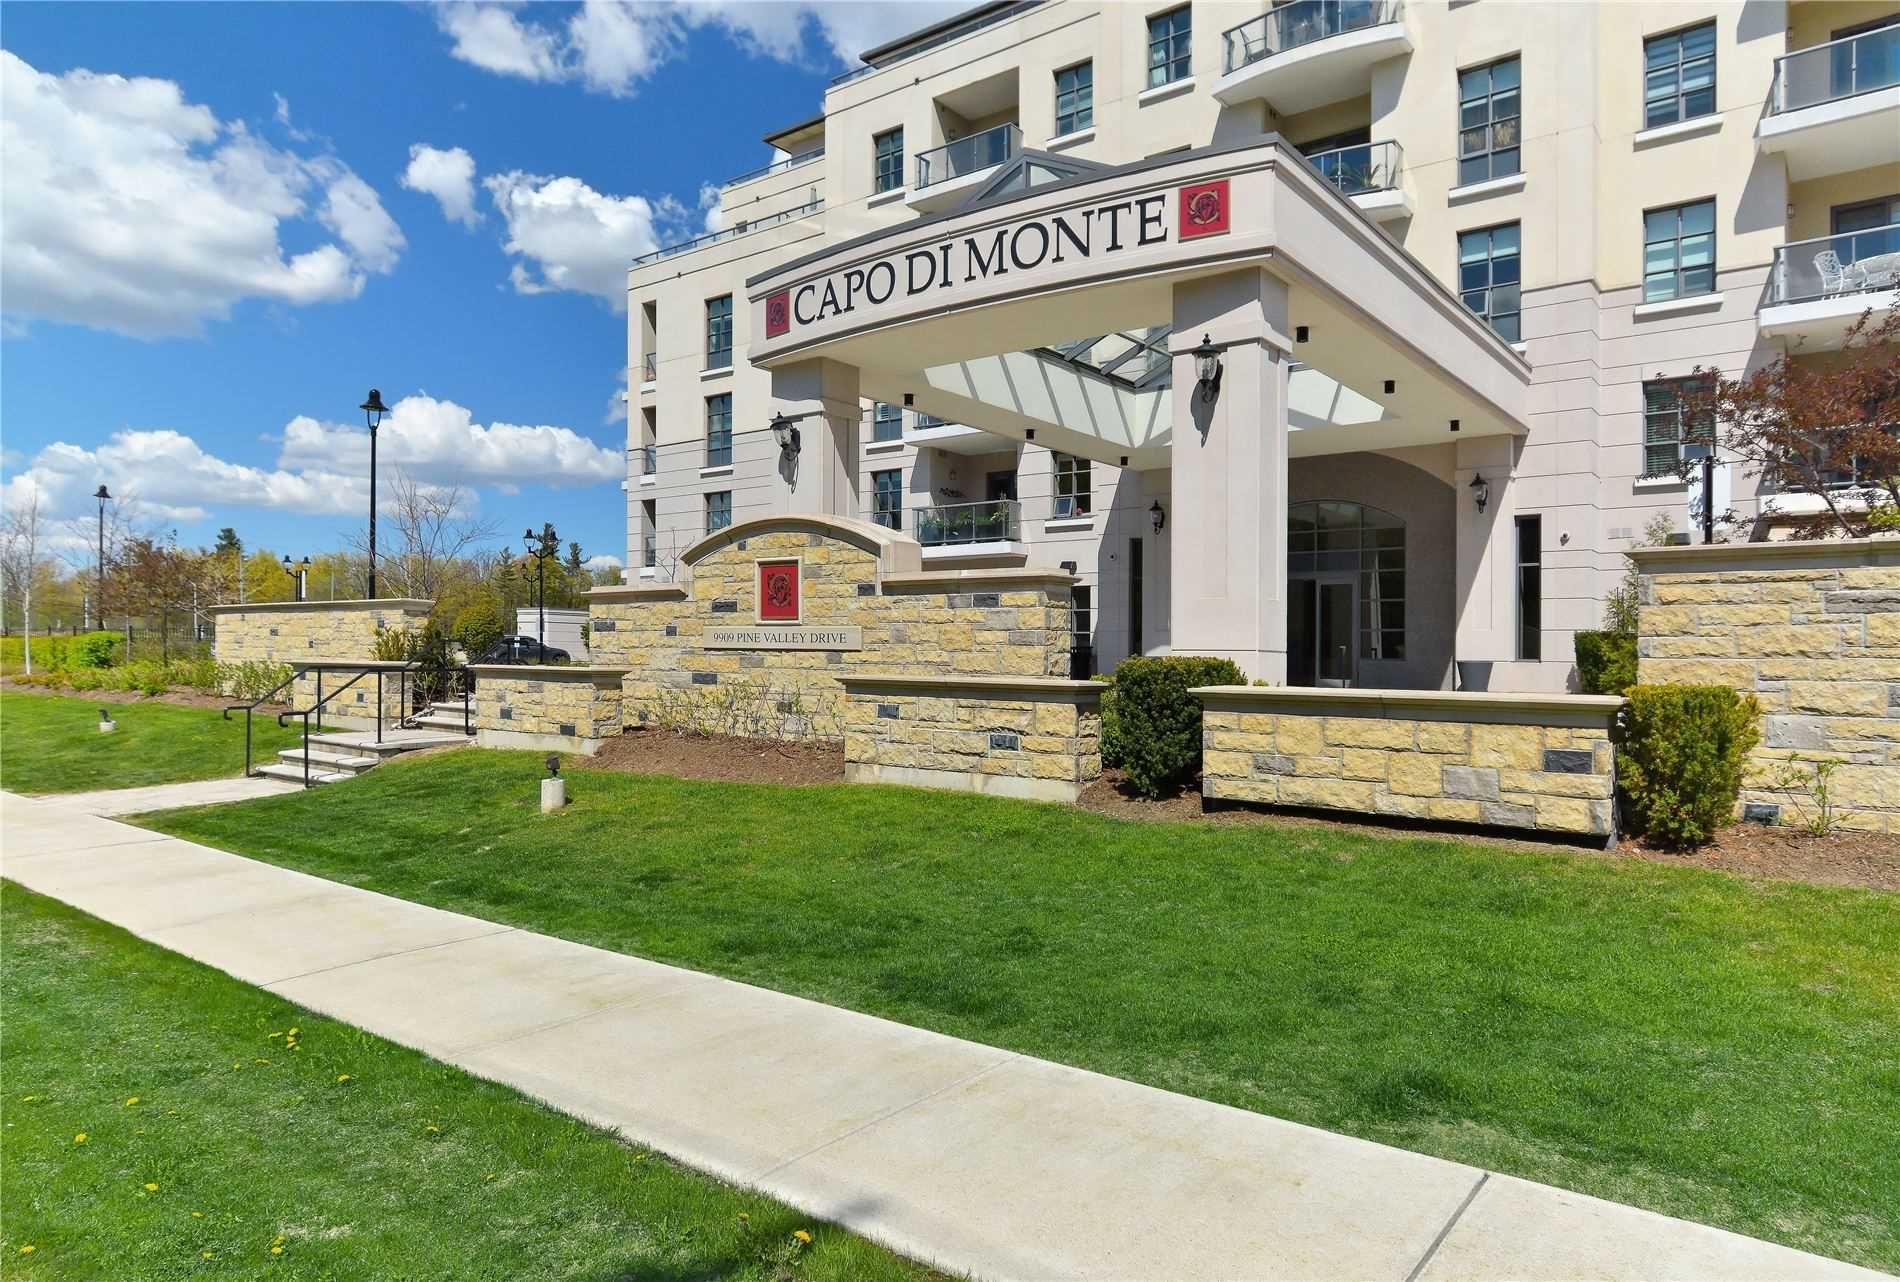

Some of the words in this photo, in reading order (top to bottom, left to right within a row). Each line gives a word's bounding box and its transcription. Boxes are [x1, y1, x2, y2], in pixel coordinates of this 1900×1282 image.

[793, 261, 896, 325] CAPO
[905, 243, 953, 295] DI
[964, 195, 1168, 282] MONTE
[713, 632, 735, 642] 9909
[736, 632, 761, 644] PINE
[763, 632, 807, 644] VALLEY
[809, 632, 848, 644] DRIVE
